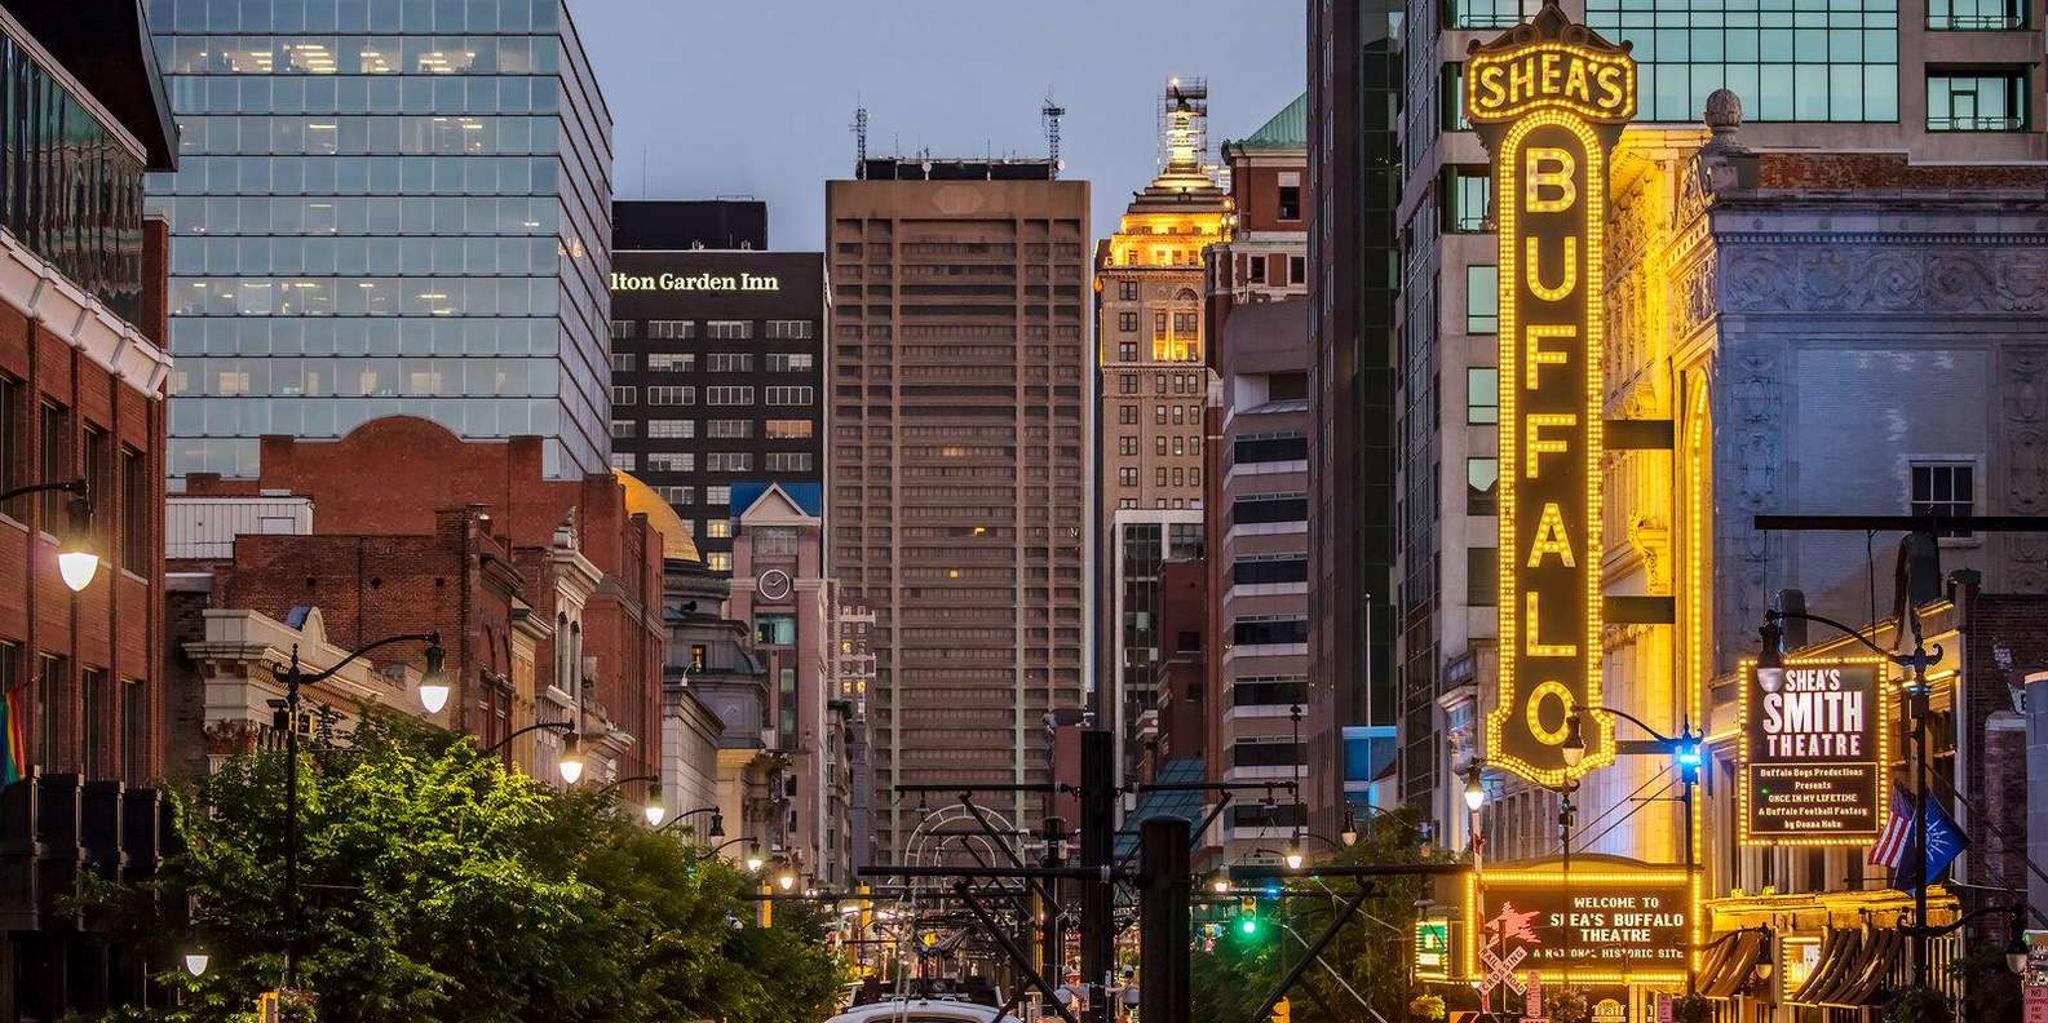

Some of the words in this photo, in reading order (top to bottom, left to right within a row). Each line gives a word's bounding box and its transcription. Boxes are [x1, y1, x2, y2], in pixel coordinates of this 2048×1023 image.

[1480, 54, 1623, 108] SHEA'S
[610, 273, 656, 290] lton
[659, 273, 736, 290] Garden
[741, 273, 779, 290] Inn
[1526, 147, 1577, 745] BUFFALO
[1785, 669, 1840, 692] SHEA'S
[1762, 691, 1863, 734] SMITH
[1767, 734, 1861, 757] THEATRE
[1760, 769, 1792, 777] Buffalo
[1793, 768, 1815, 778] Boys
[1815, 768, 1863, 777] Productions
[1795, 781, 1831, 790] Presents
[1769, 794, 1790, 802] ONCE
[1792, 794, 1802, 802] IN
[1803, 794, 1816, 802] MY
[1817, 793, 1858, 802] LIFETIME
[1766, 807, 1798, 815] Buffalo
[1799, 807, 1833, 815] Football
[1834, 807, 1867, 816] Fantasy
[1784, 820, 1795, 829] by
[1574, 897, 1635, 908] WELCOME
[1641, 897, 1659, 908] TO
[1613, 913, 1684, 926] BUFFALO
[1581, 929, 1650, 942] THEATRE
[1533, 948, 1540, 958] A
[1658, 948, 1684, 958] SITE
[1481, 949, 1498, 968] RAIL
[1505, 973, 1525, 993] ROAD
[1482, 950, 1523, 991] CROSSING
